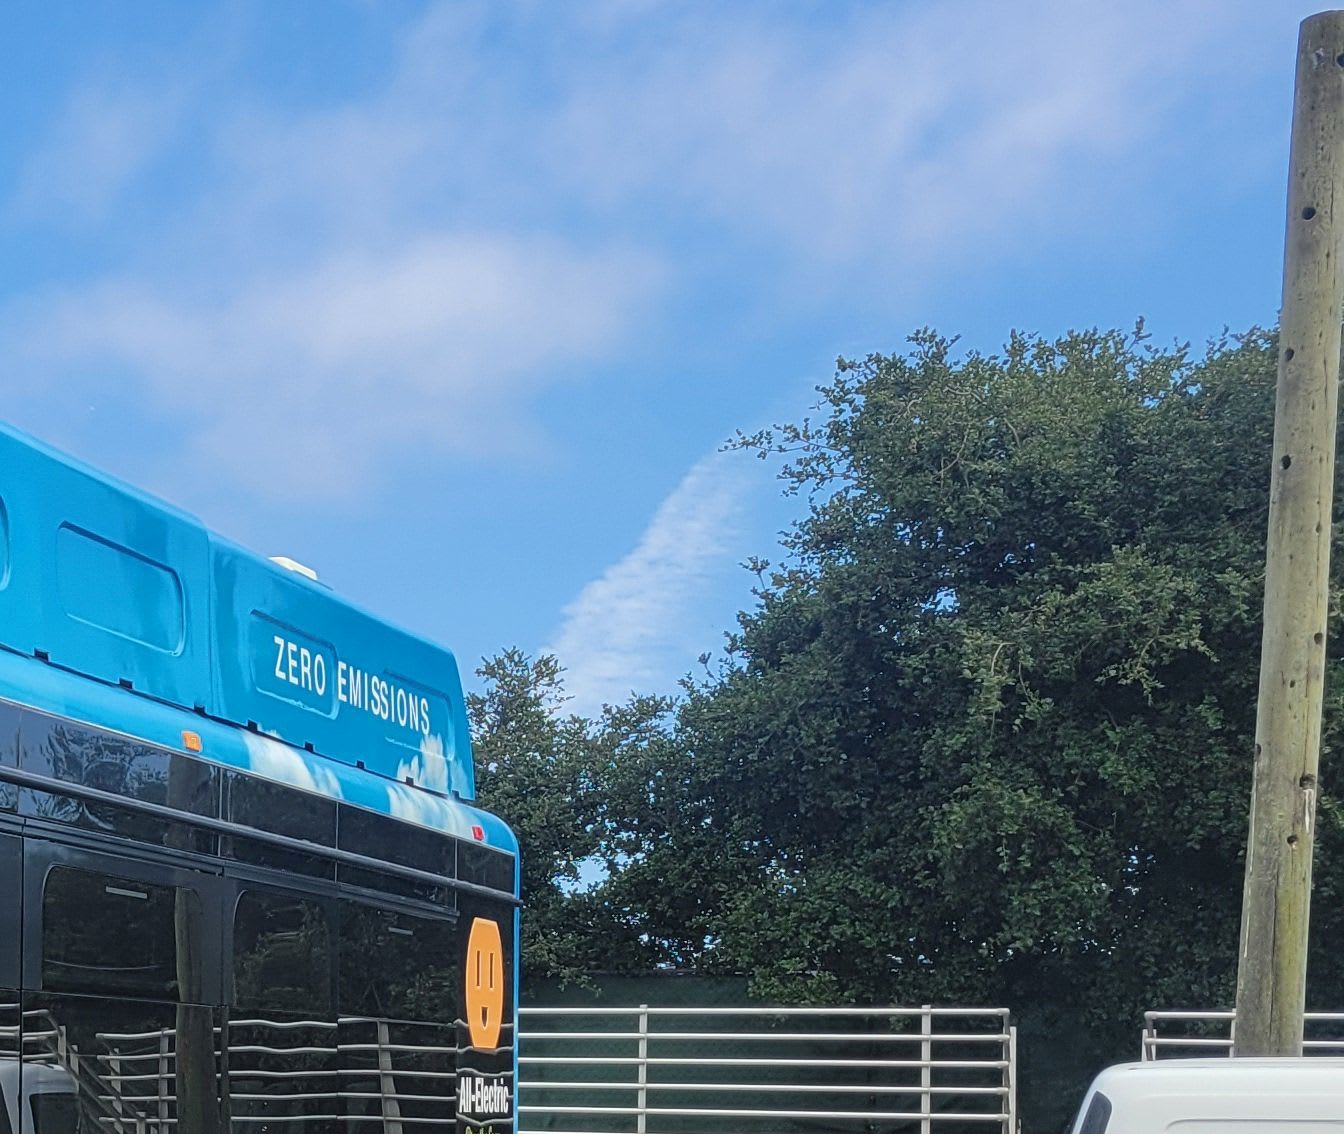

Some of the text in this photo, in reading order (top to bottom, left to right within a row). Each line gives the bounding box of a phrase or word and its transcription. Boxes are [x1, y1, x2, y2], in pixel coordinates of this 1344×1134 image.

[274, 635, 430, 735] ZERO EMISSIONS
[459, 1077, 509, 1113] All-Electric
